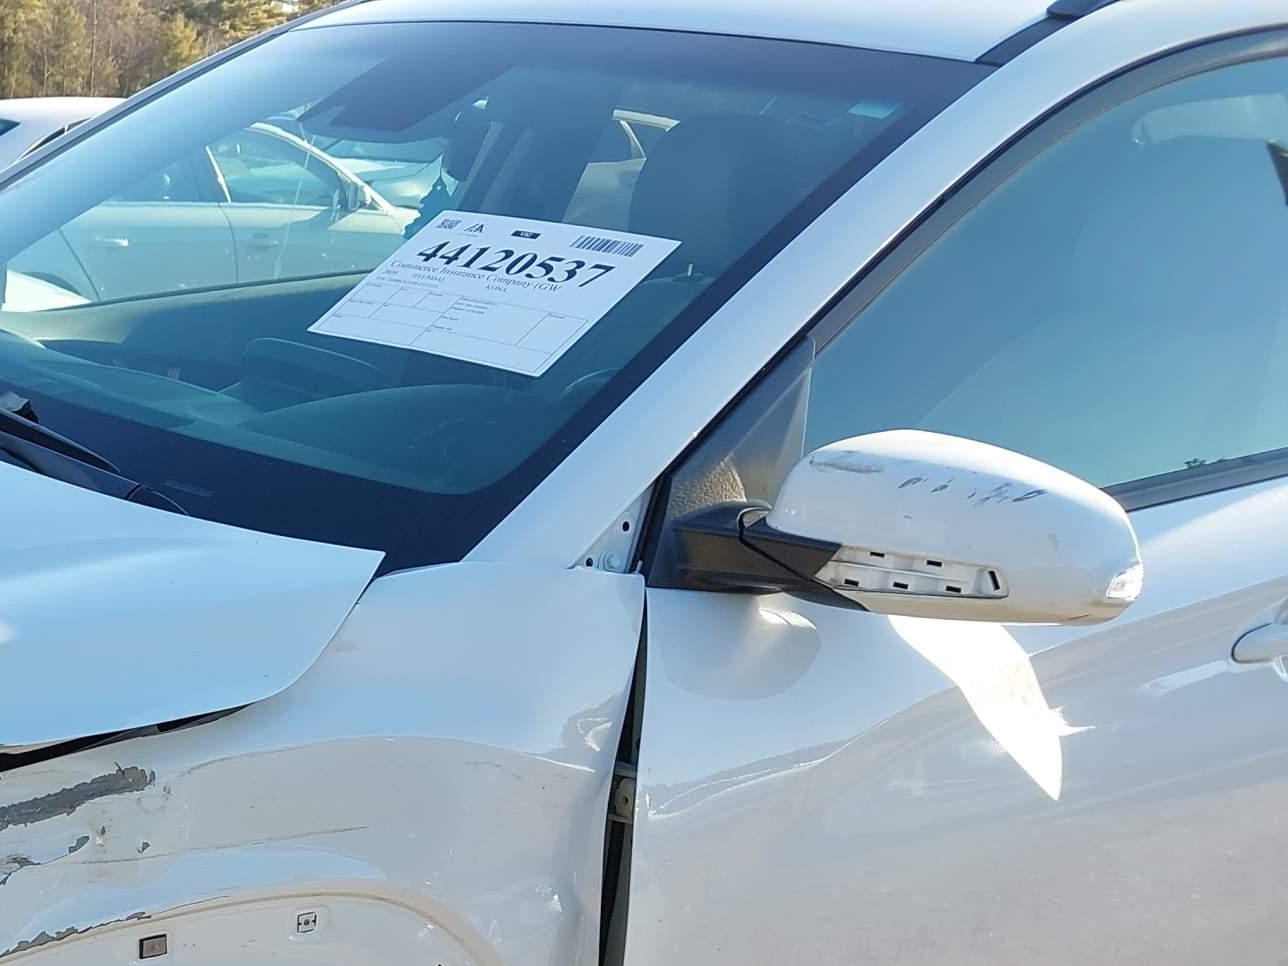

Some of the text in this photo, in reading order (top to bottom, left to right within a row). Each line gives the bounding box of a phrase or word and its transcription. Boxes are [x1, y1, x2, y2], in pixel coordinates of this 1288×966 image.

[390, 260, 562, 293] Commerce Insurance Company (GW
[416, 240, 616, 289] 44120537
